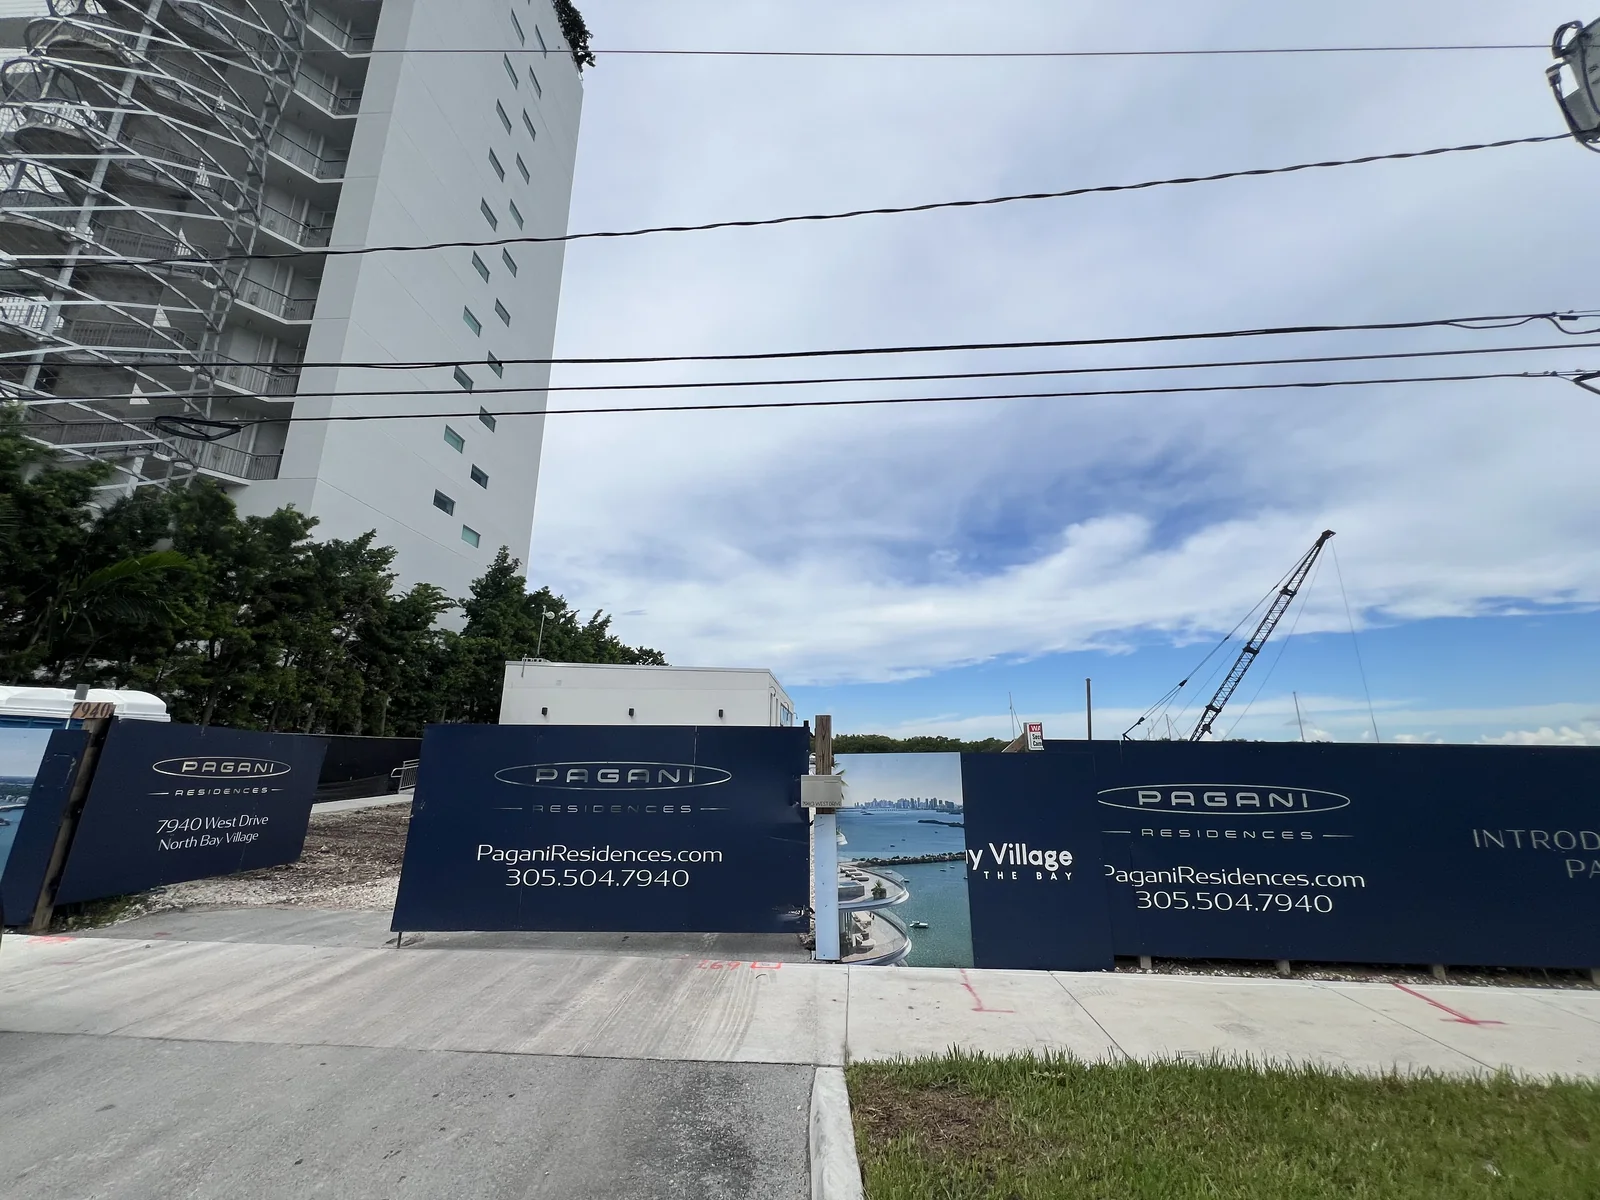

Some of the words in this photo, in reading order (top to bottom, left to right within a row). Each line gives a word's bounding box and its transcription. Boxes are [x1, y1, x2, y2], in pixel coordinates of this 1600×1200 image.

[70, 702, 112, 718] 7940
[181, 761, 275, 773] PAGANI
[535, 768, 695, 784] PAGANI
[174, 787, 269, 796] RESIDENCES
[1138, 791, 1309, 808] PAGANI
[532, 804, 693, 814] RESIDENCES
[156, 817, 202, 834] 7940
[205, 816, 238, 829] West
[239, 814, 269, 827] Drive
[158, 836, 197, 851] North
[199, 834, 223, 847] Bay
[226, 831, 259, 843] Village
[1142, 828, 1314, 840] RESIDENCES
[1473, 828, 1600, 850] INTROD
[477, 844, 723, 866] PaganiResidences.com
[965, 849, 983, 870] y
[988, 843, 1073, 871] Village
[505, 869, 690, 888] 305.504.7940
[984, 871, 1018, 880] THE
[1036, 871, 1073, 881] BAY
[1104, 864, 1366, 889] PaganiResidences.com
[1137, 892, 1333, 913] 305.504.7940
